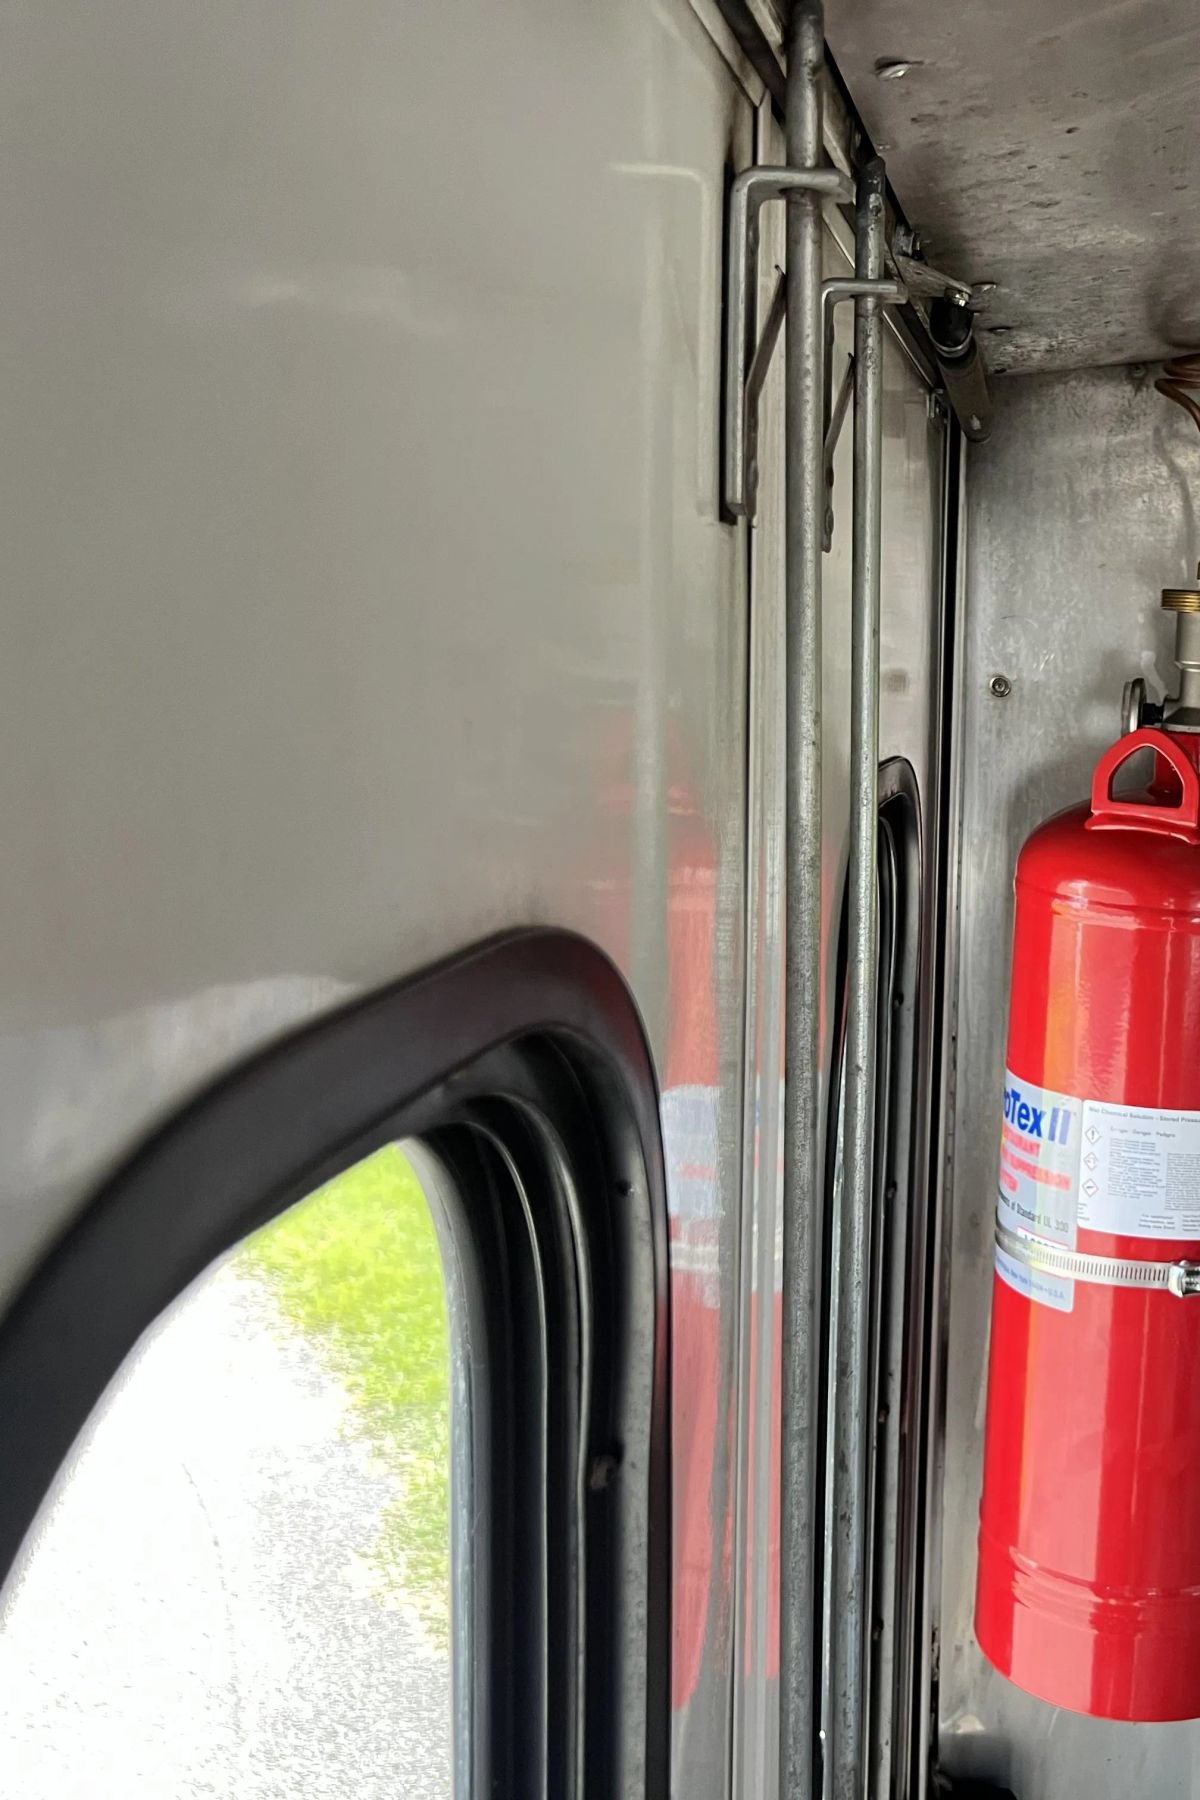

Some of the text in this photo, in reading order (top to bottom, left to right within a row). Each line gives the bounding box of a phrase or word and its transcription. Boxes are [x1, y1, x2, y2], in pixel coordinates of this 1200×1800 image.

[1003, 1086, 1046, 1138] oTex
[1101, 1107, 1128, 1117] Chemical
[1016, 1202, 1042, 1225] Standard
[1043, 1214, 1053, 1228] UL
[1056, 1218, 1070, 1233] 300
